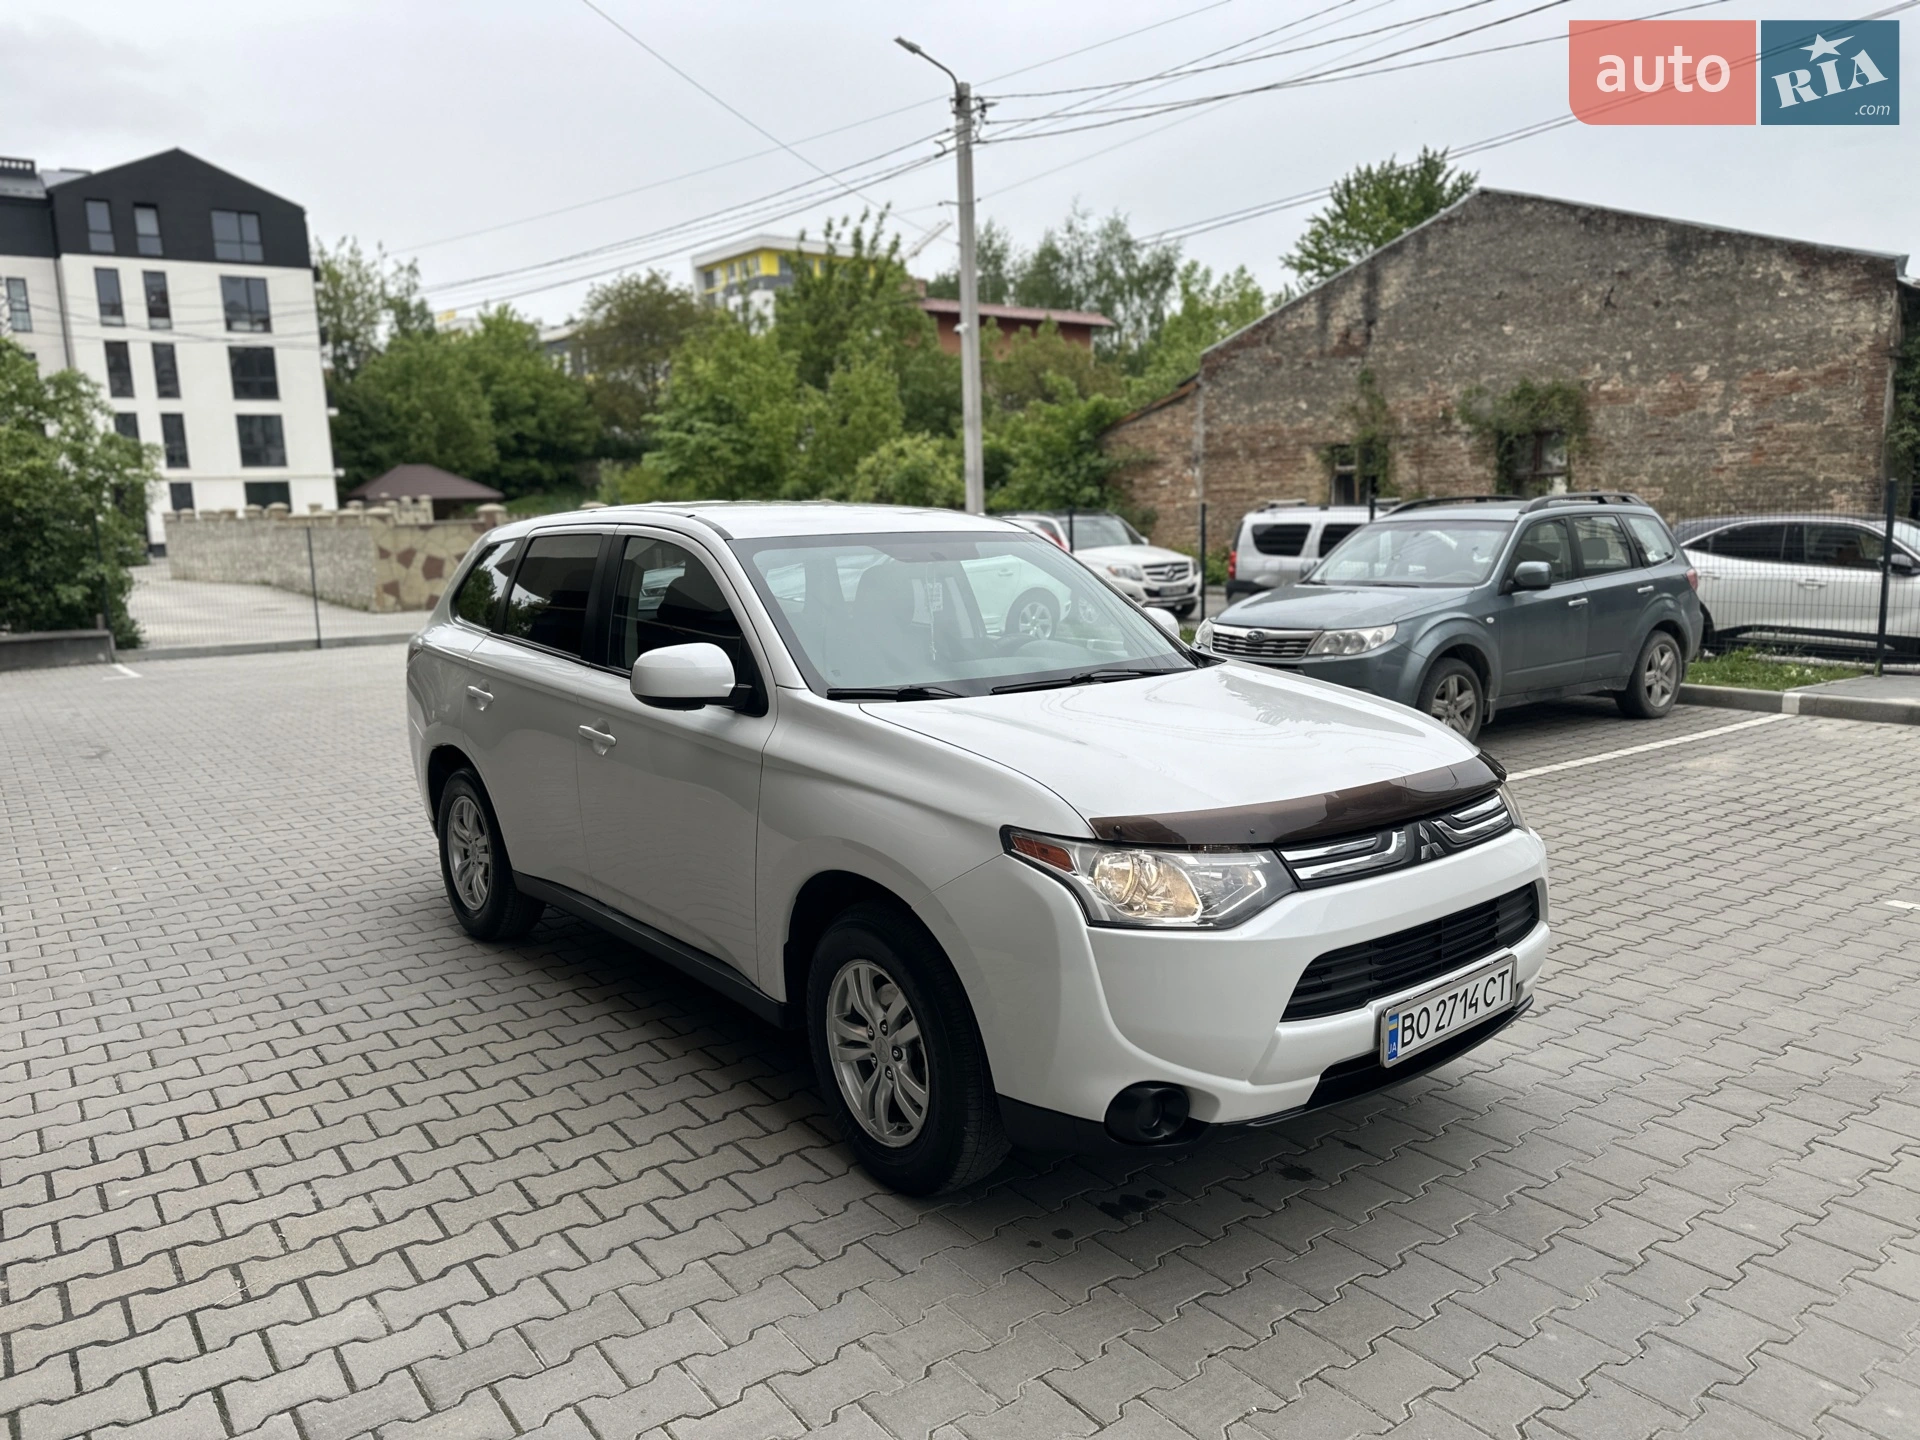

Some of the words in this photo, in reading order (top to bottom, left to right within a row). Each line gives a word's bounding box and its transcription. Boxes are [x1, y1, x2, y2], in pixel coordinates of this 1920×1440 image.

[1401, 1007, 1430, 1048] BO
[1434, 983, 1480, 1033] 2714
[1483, 969, 1509, 1007] CT
